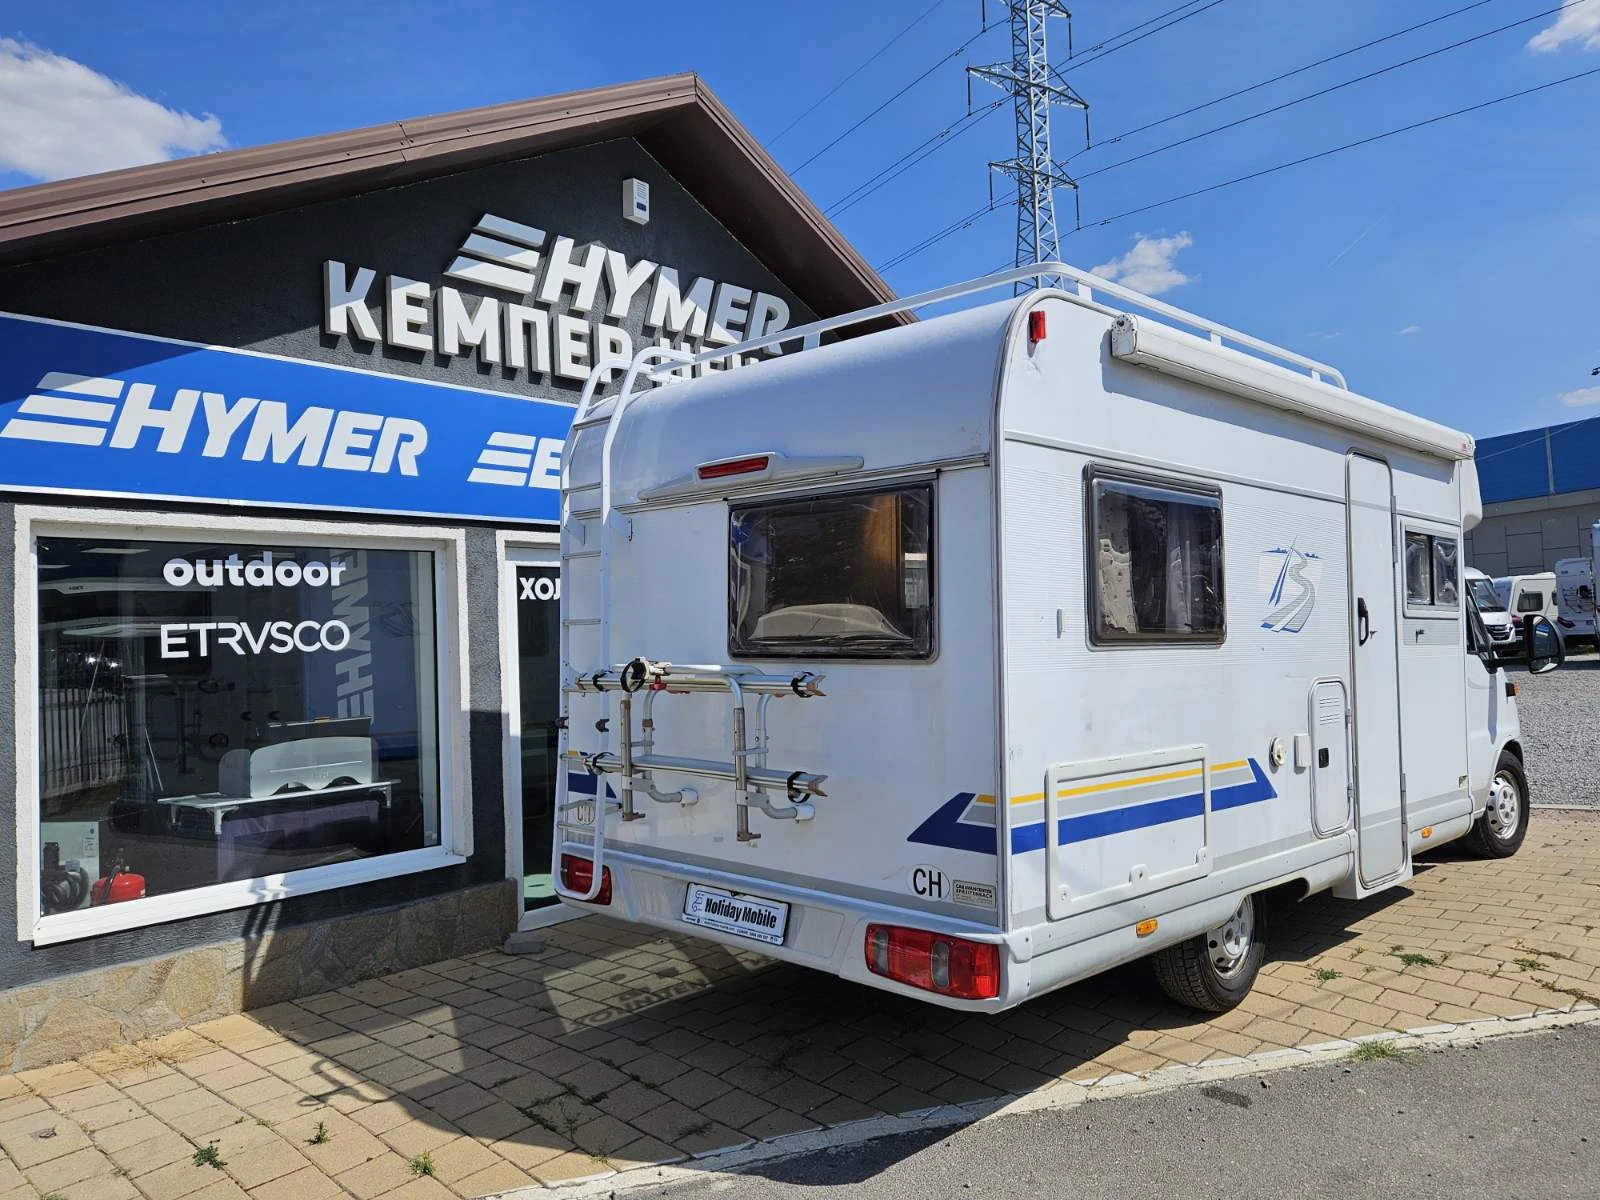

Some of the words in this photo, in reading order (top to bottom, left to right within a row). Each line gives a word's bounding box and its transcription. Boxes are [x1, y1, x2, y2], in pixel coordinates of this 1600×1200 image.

[538, 235, 790, 355] HYMER
[323, 259, 633, 383] КЕМПЕР
[110, 382, 428, 476] HYMER
[163, 551, 346, 586] outdoor
[161, 620, 350, 659] ETRVSCO
[912, 867, 942, 898] CH
[704, 897, 743, 922] Holiday
[742, 907, 777, 928] Mobile
